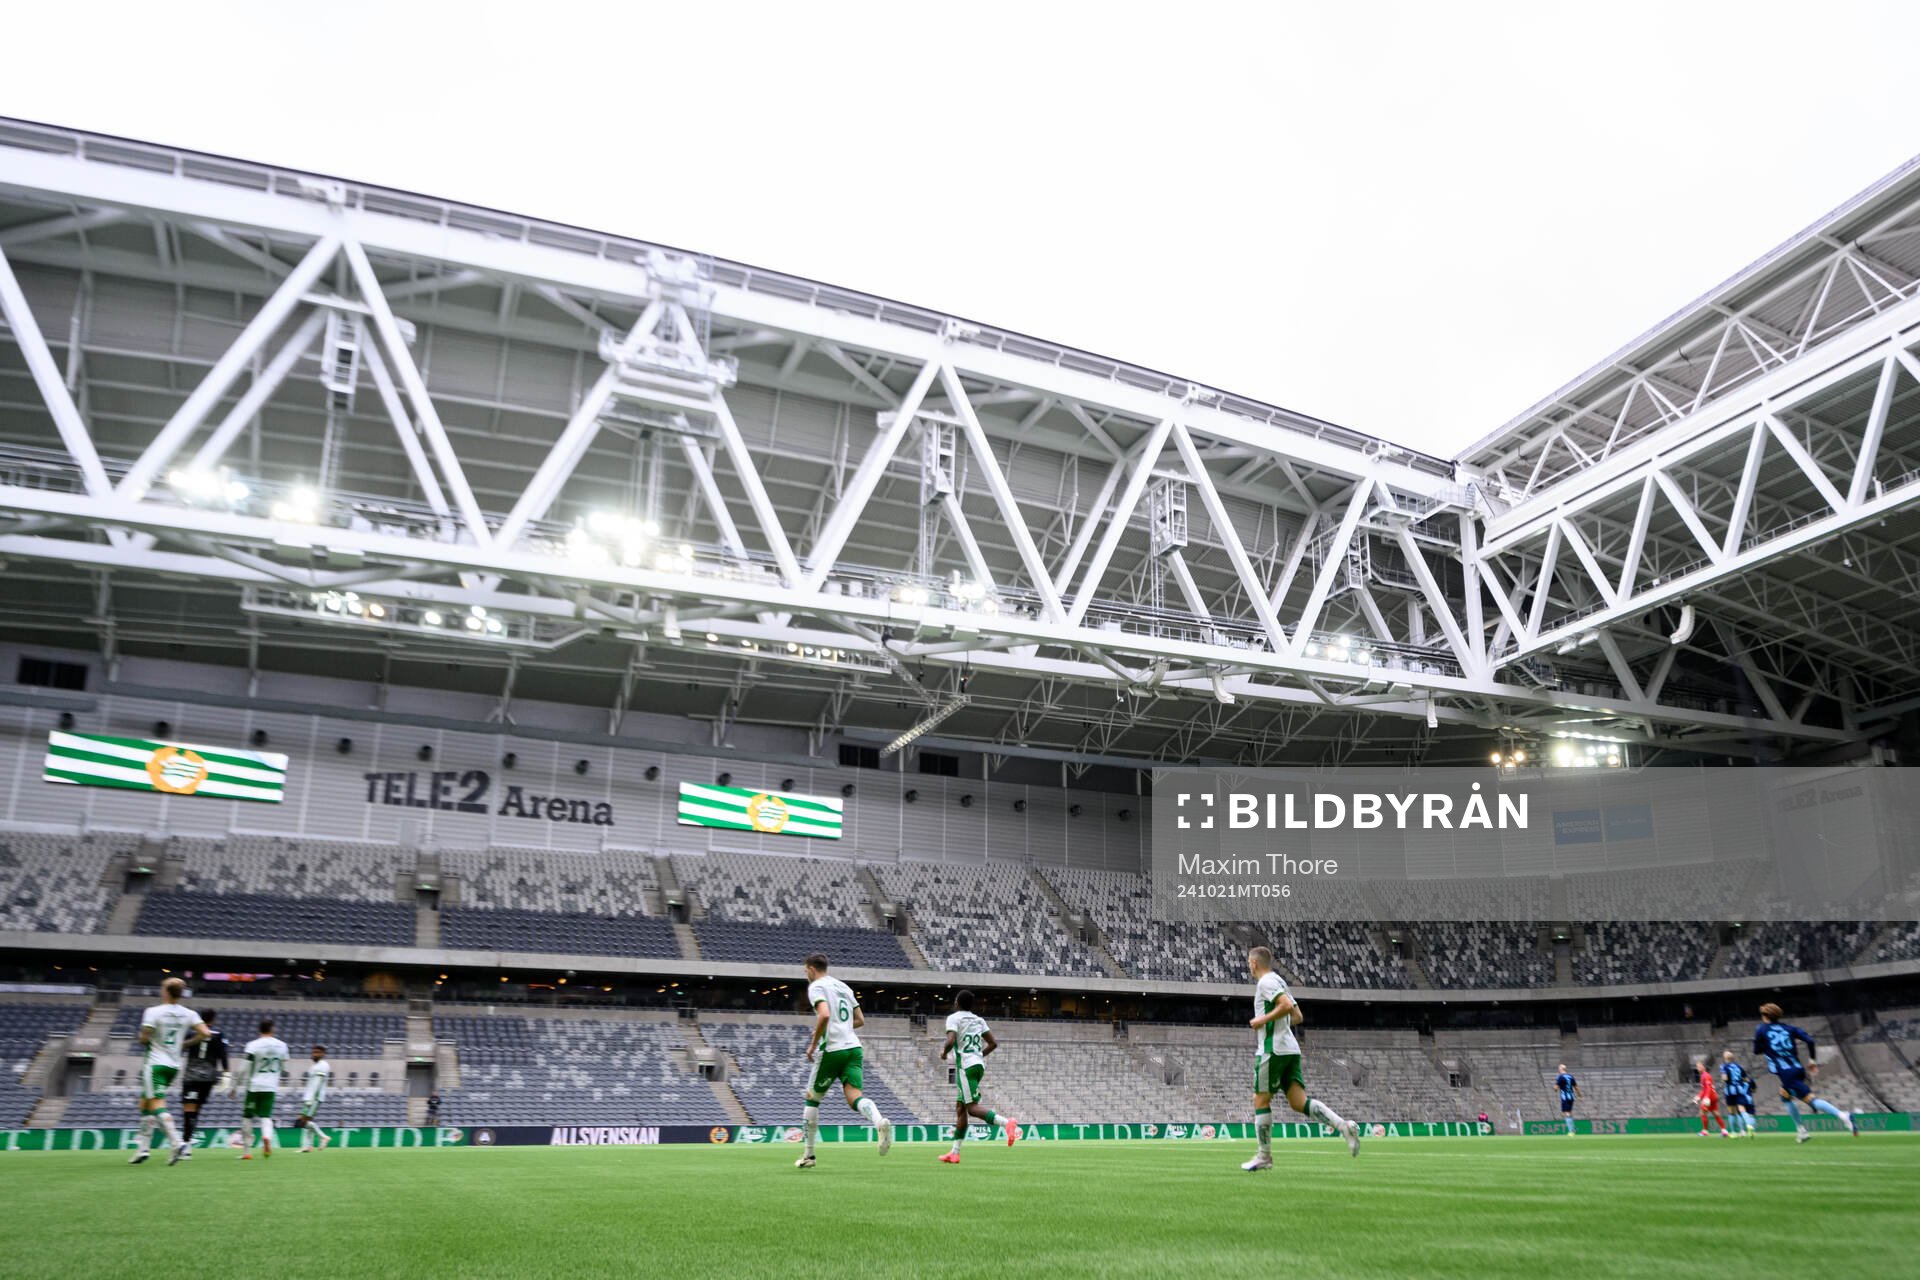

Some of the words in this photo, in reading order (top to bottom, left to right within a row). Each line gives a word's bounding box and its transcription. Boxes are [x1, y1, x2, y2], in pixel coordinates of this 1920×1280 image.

[363, 770, 491, 814] TELE2
[497, 785, 615, 826] Arena
[838, 1000, 850, 1022] 6
[1767, 1029, 1794, 1051] 26
[550, 1127, 660, 1145] ALLSVENSKAN
[1592, 1120, 1629, 1134] BST
